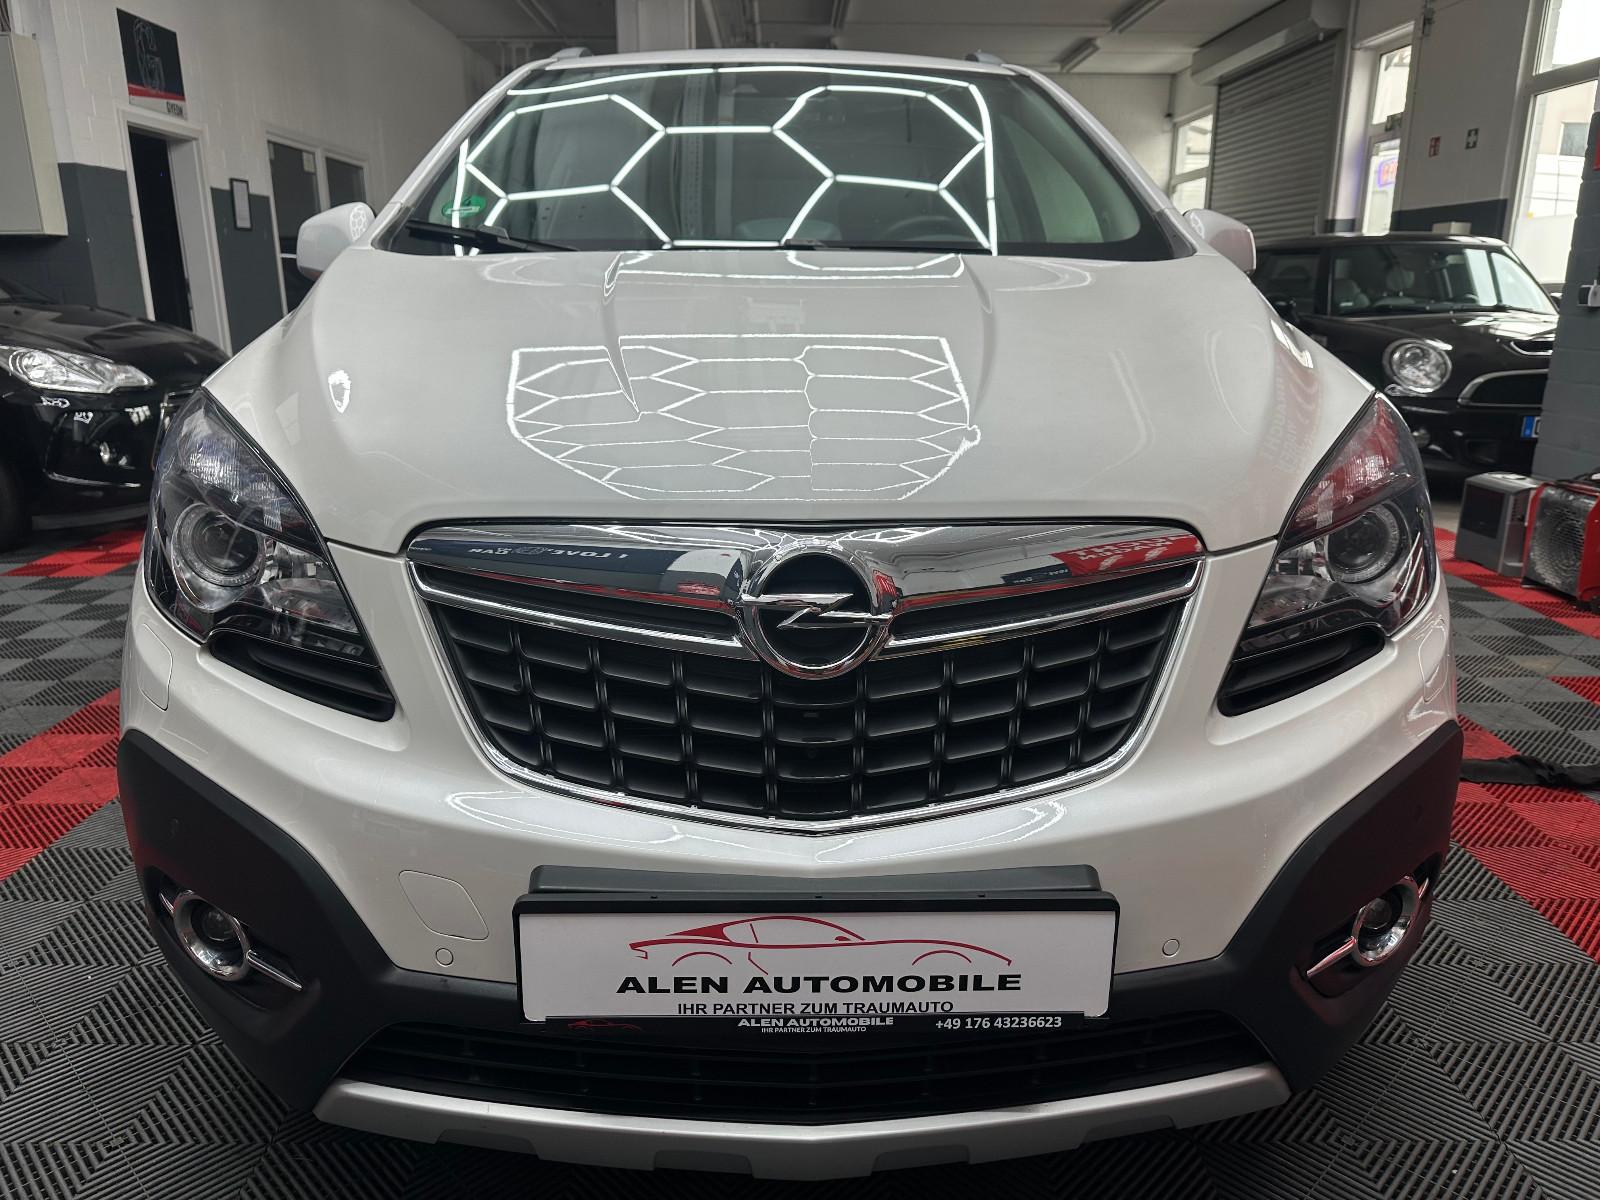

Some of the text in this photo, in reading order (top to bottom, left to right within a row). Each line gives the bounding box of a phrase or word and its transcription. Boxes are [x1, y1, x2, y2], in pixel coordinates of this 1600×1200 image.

[616, 974, 1021, 994] ALEN AUTOMOBILE
[677, 1001, 954, 1015] IHR PARTNER ZUM TRAUMAUTO
[737, 1017, 894, 1027] ALEN AUTOMOBILE
[935, 1016, 1062, 1030] +49 176 43236623
